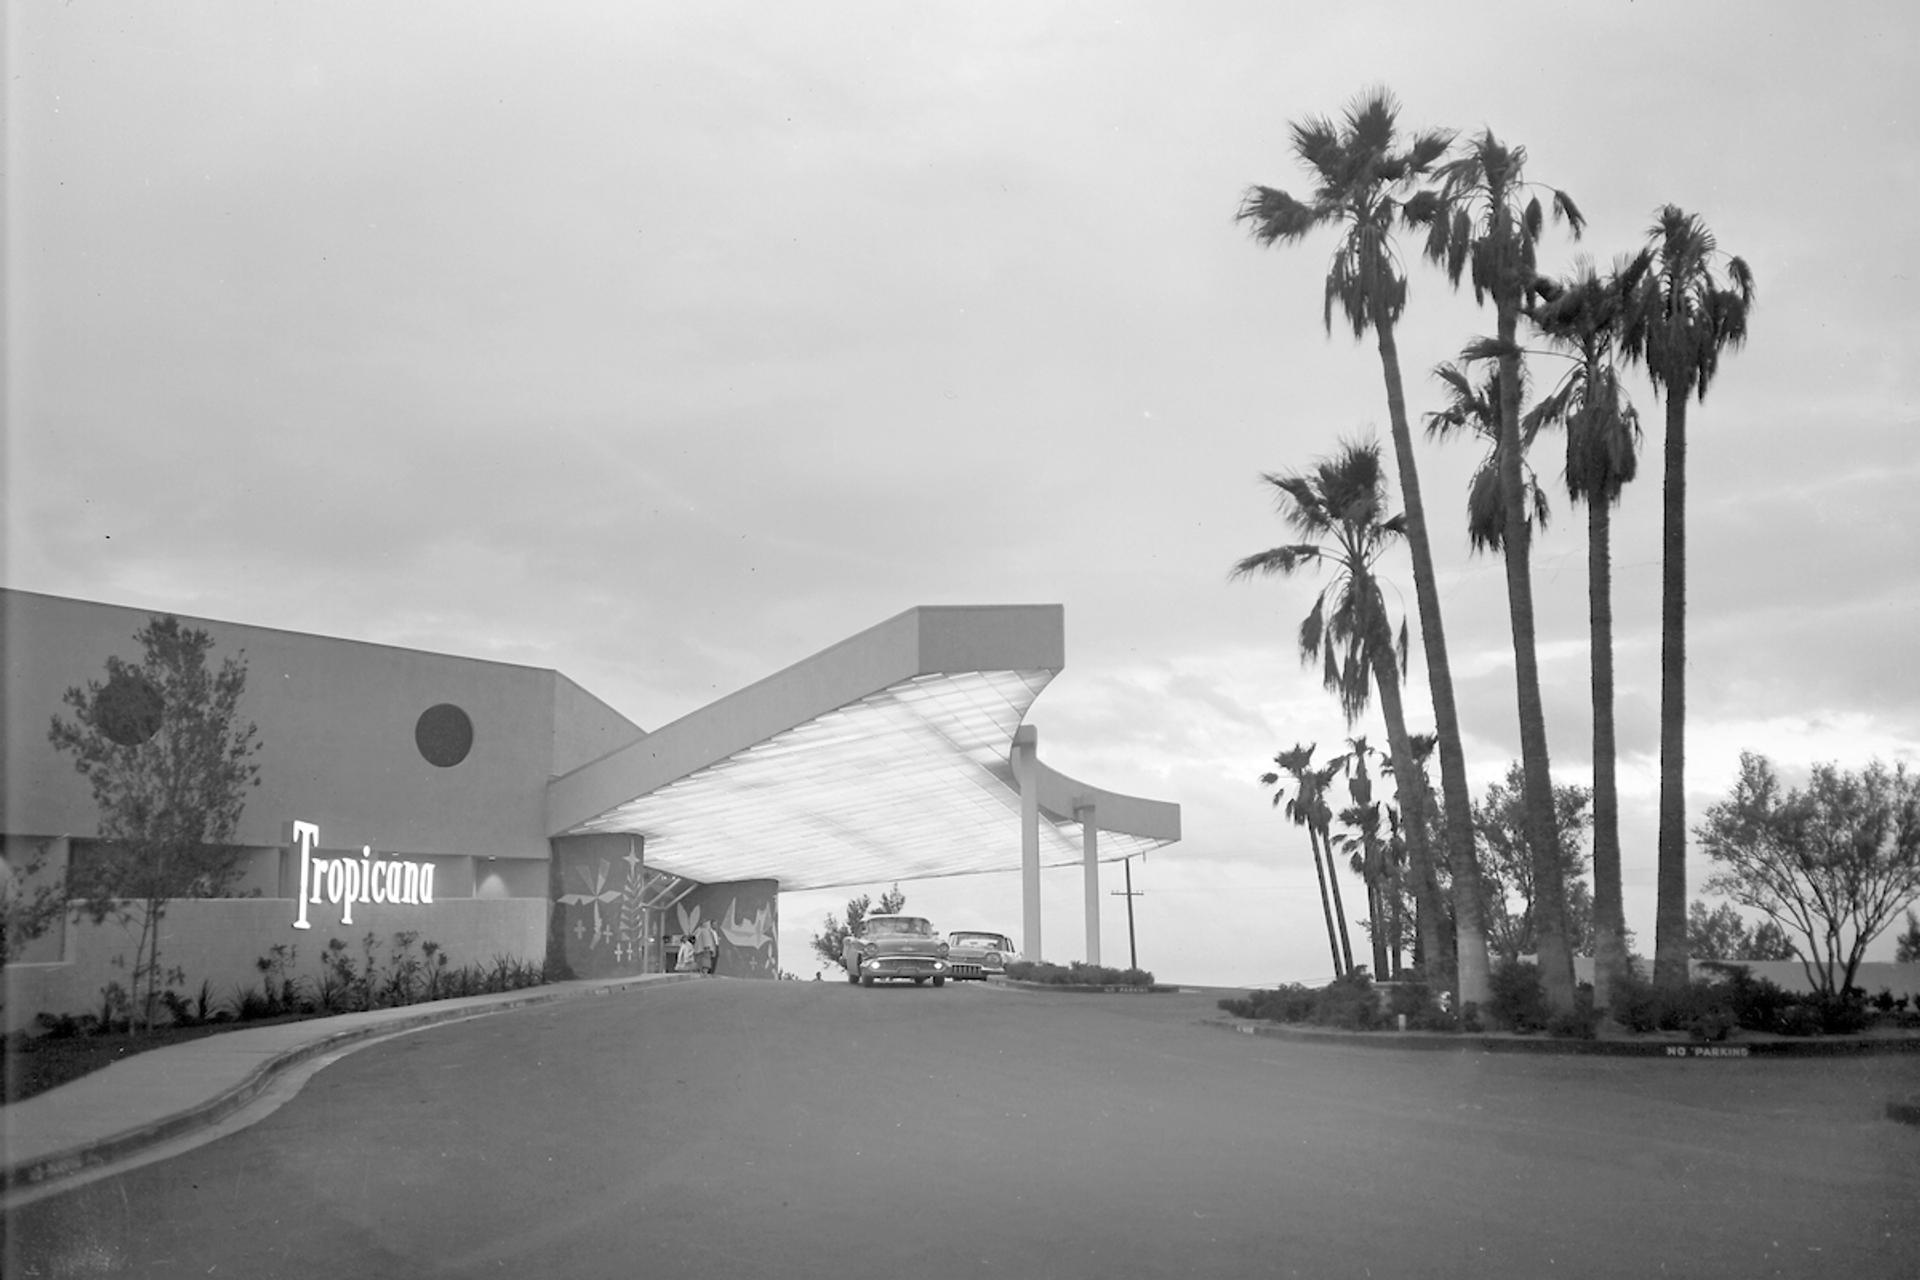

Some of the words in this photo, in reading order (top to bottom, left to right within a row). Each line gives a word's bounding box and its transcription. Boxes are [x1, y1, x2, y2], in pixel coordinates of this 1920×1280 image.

[293, 820, 435, 929] Tropicana
[1666, 1046, 1686, 1056] NO
[1695, 1047, 1749, 1057] PARKING
